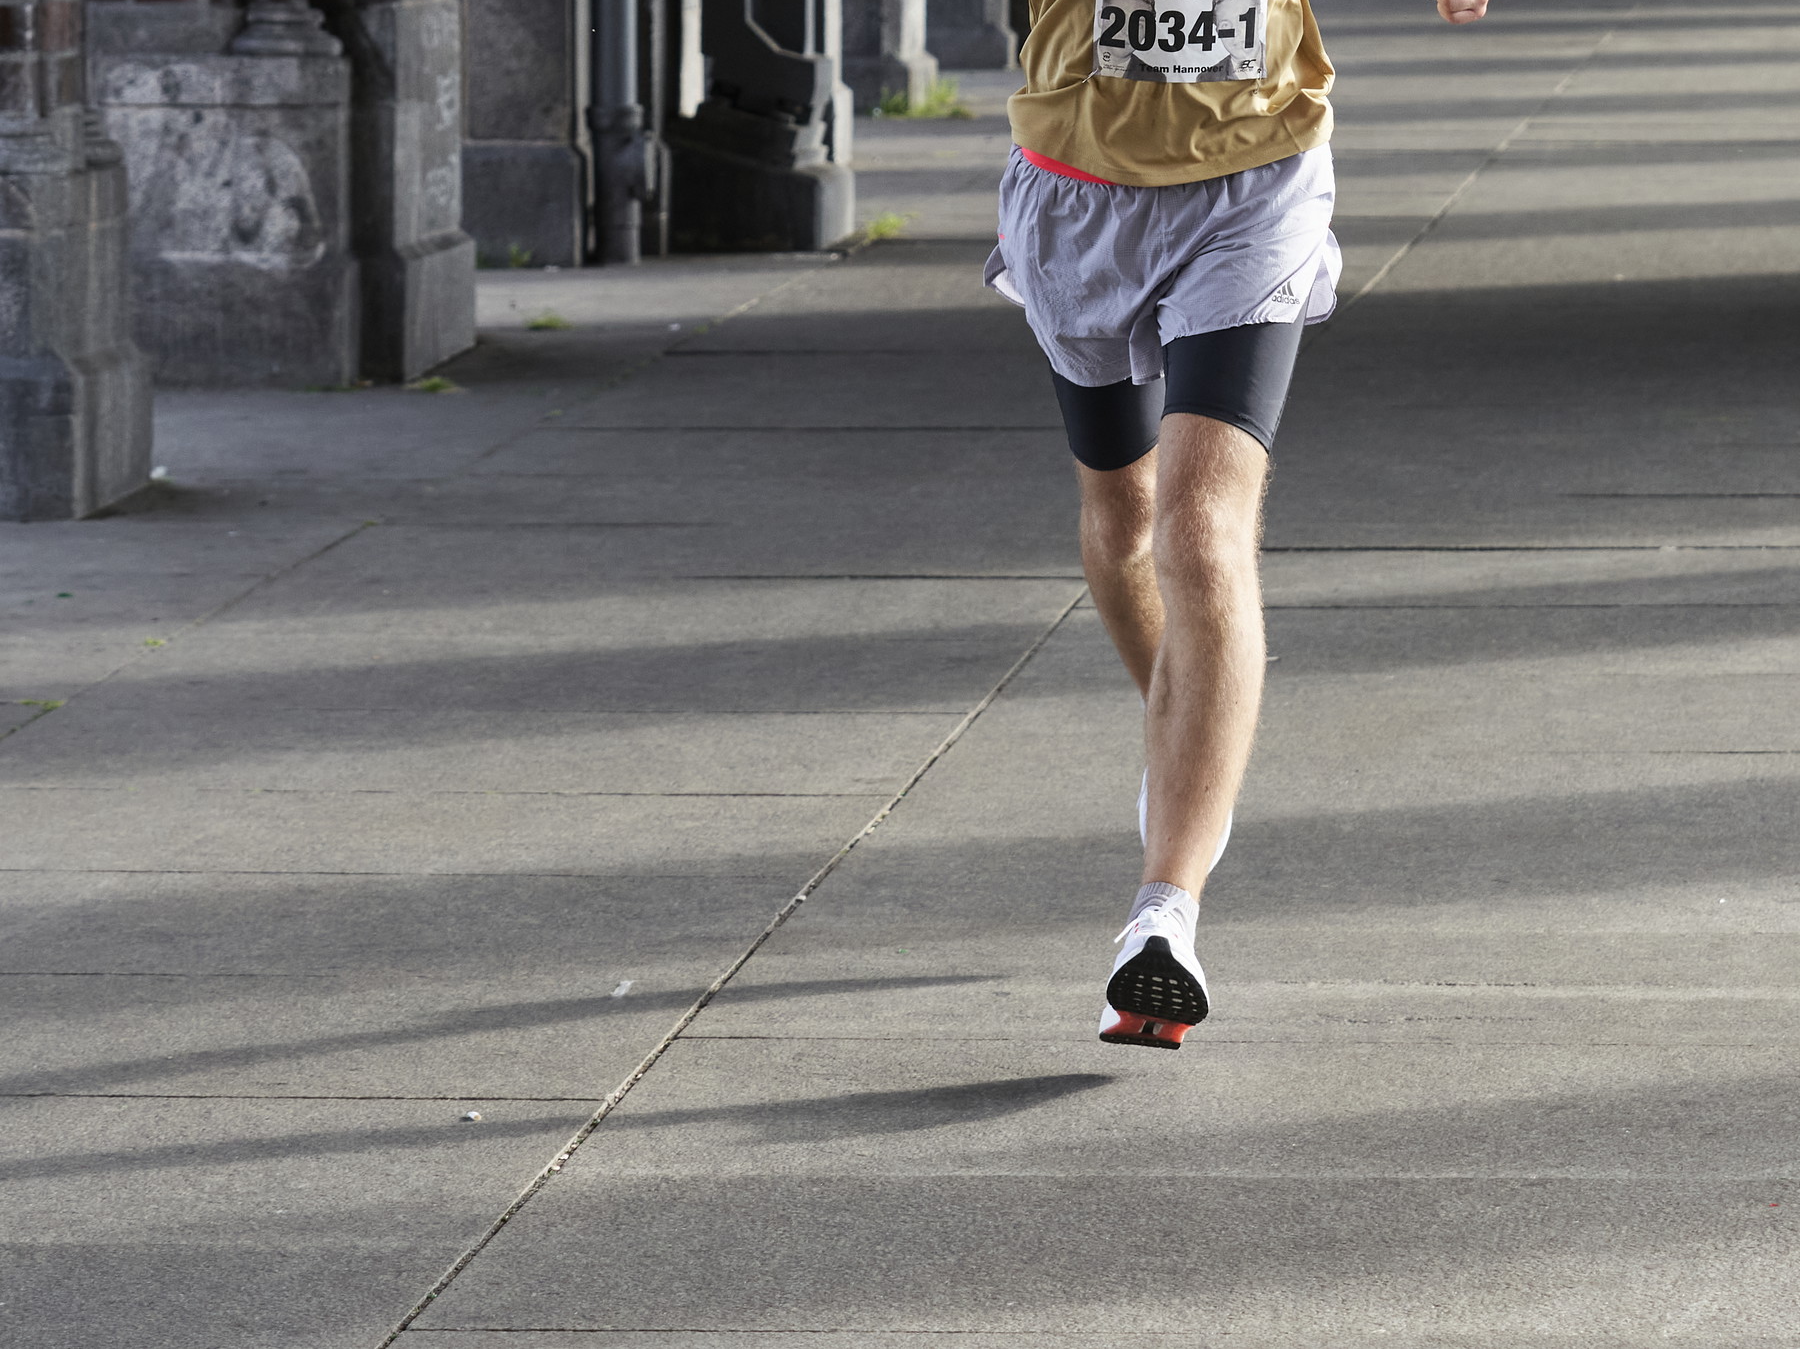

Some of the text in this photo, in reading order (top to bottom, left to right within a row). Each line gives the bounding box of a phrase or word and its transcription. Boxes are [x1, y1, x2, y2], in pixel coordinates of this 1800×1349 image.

[1099, 6, 1256, 52] 2034-1
[1140, 64, 1169, 73] Team
[1173, 65, 1223, 74] Hannover
[1272, 295, 1300, 304] adidas
